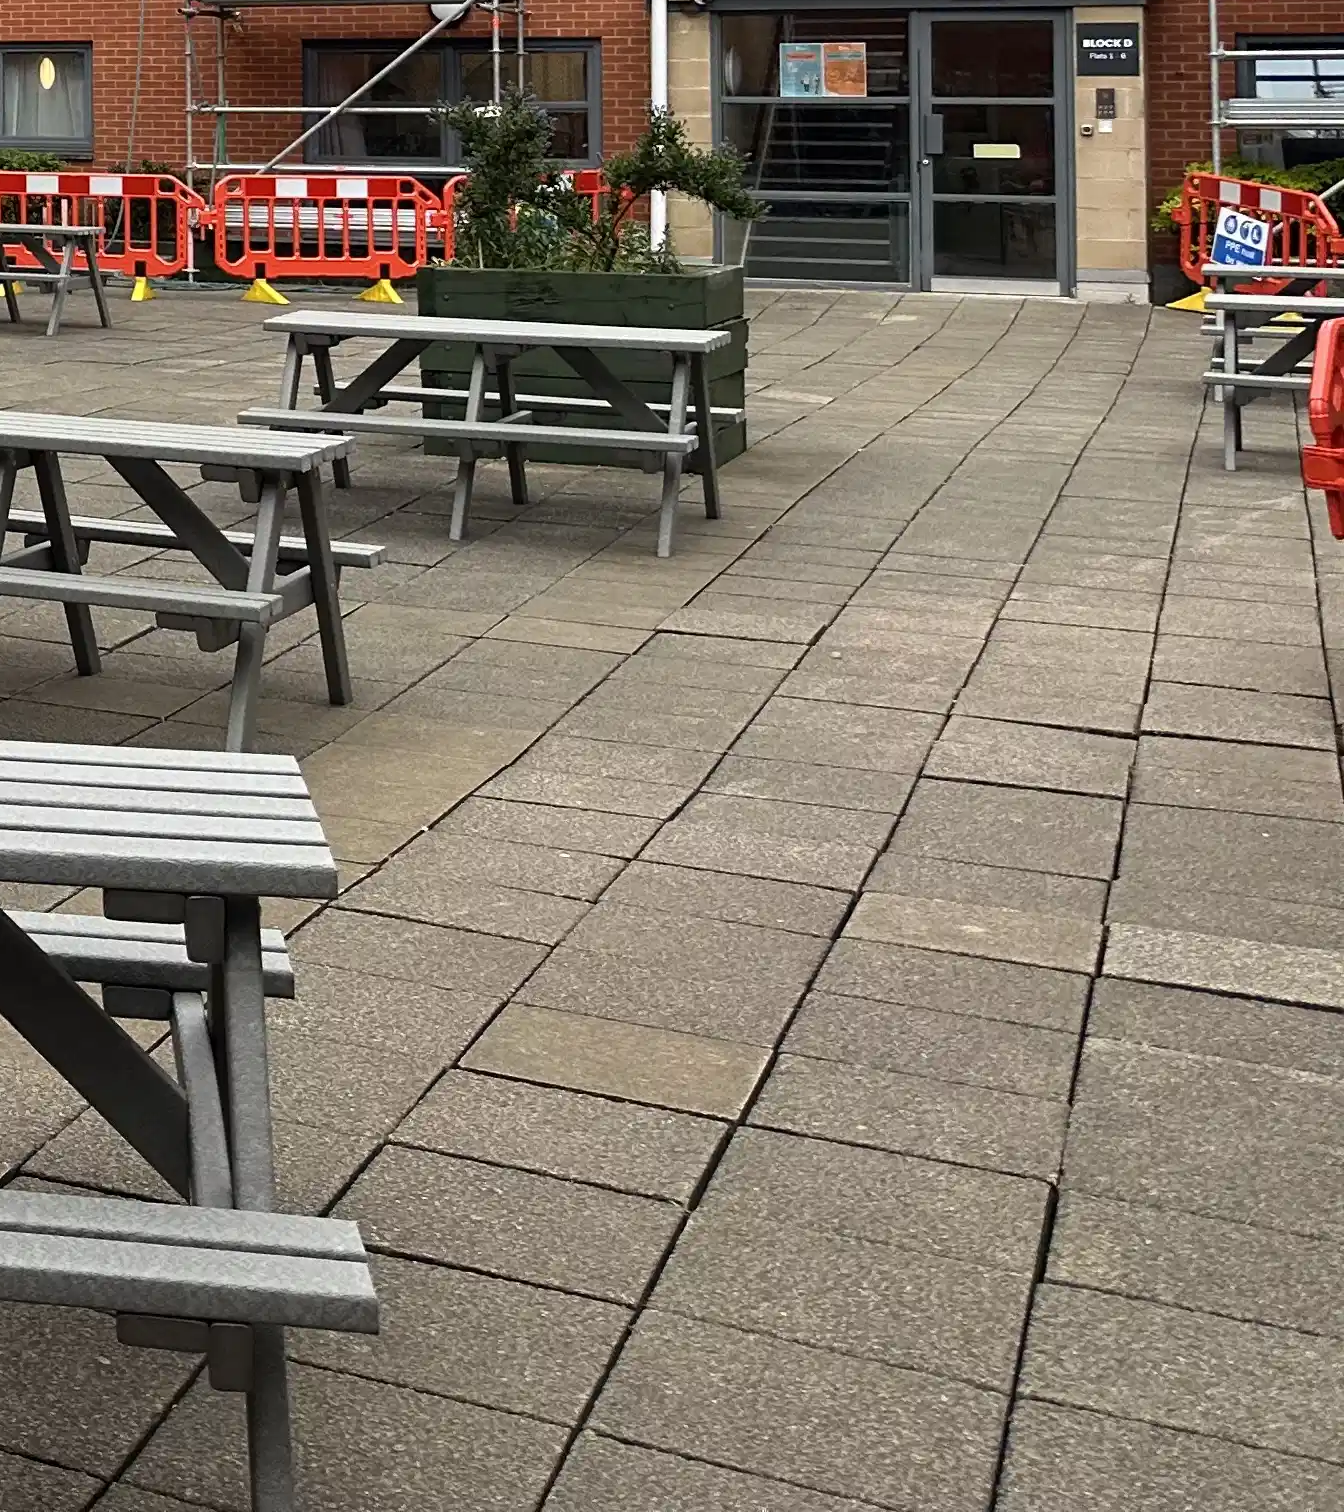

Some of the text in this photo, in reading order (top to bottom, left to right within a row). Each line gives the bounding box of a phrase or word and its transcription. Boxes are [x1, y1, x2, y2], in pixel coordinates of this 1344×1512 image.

[1082, 38, 1133, 48] BLOCK D
[1224, 240, 1241, 253] PPE
